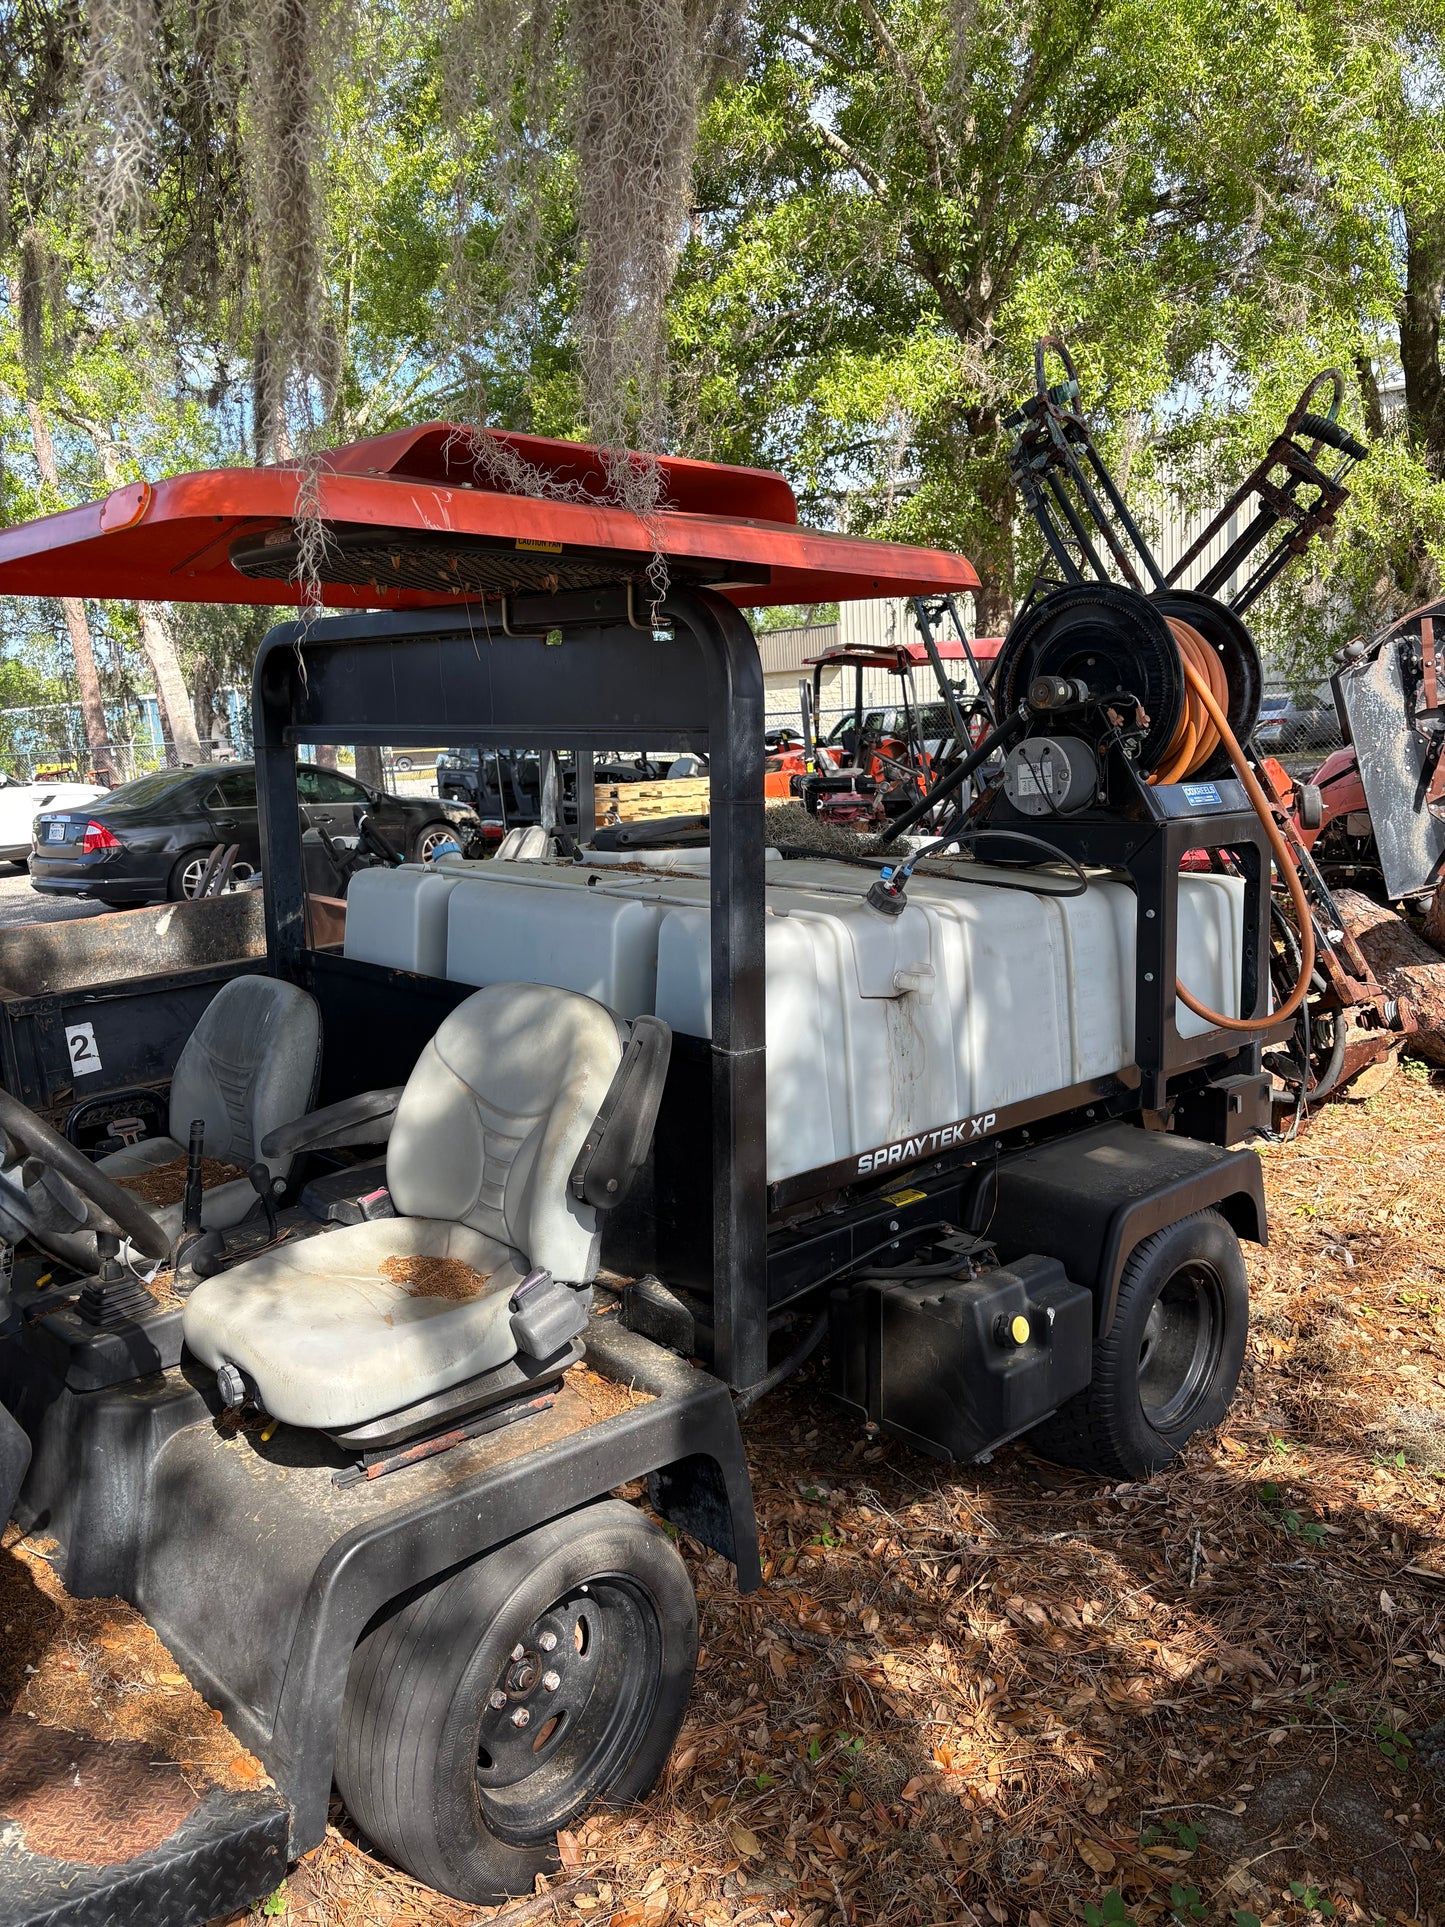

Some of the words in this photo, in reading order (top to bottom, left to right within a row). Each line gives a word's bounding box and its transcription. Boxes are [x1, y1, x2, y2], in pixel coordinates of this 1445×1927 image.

[518, 538, 546, 547] CAUTION
[548, 541, 560, 549] FAN
[70, 1034, 92, 1062] 2
[857, 1122, 966, 1175] SPRAYTEK
[969, 1113, 996, 1138] XP
